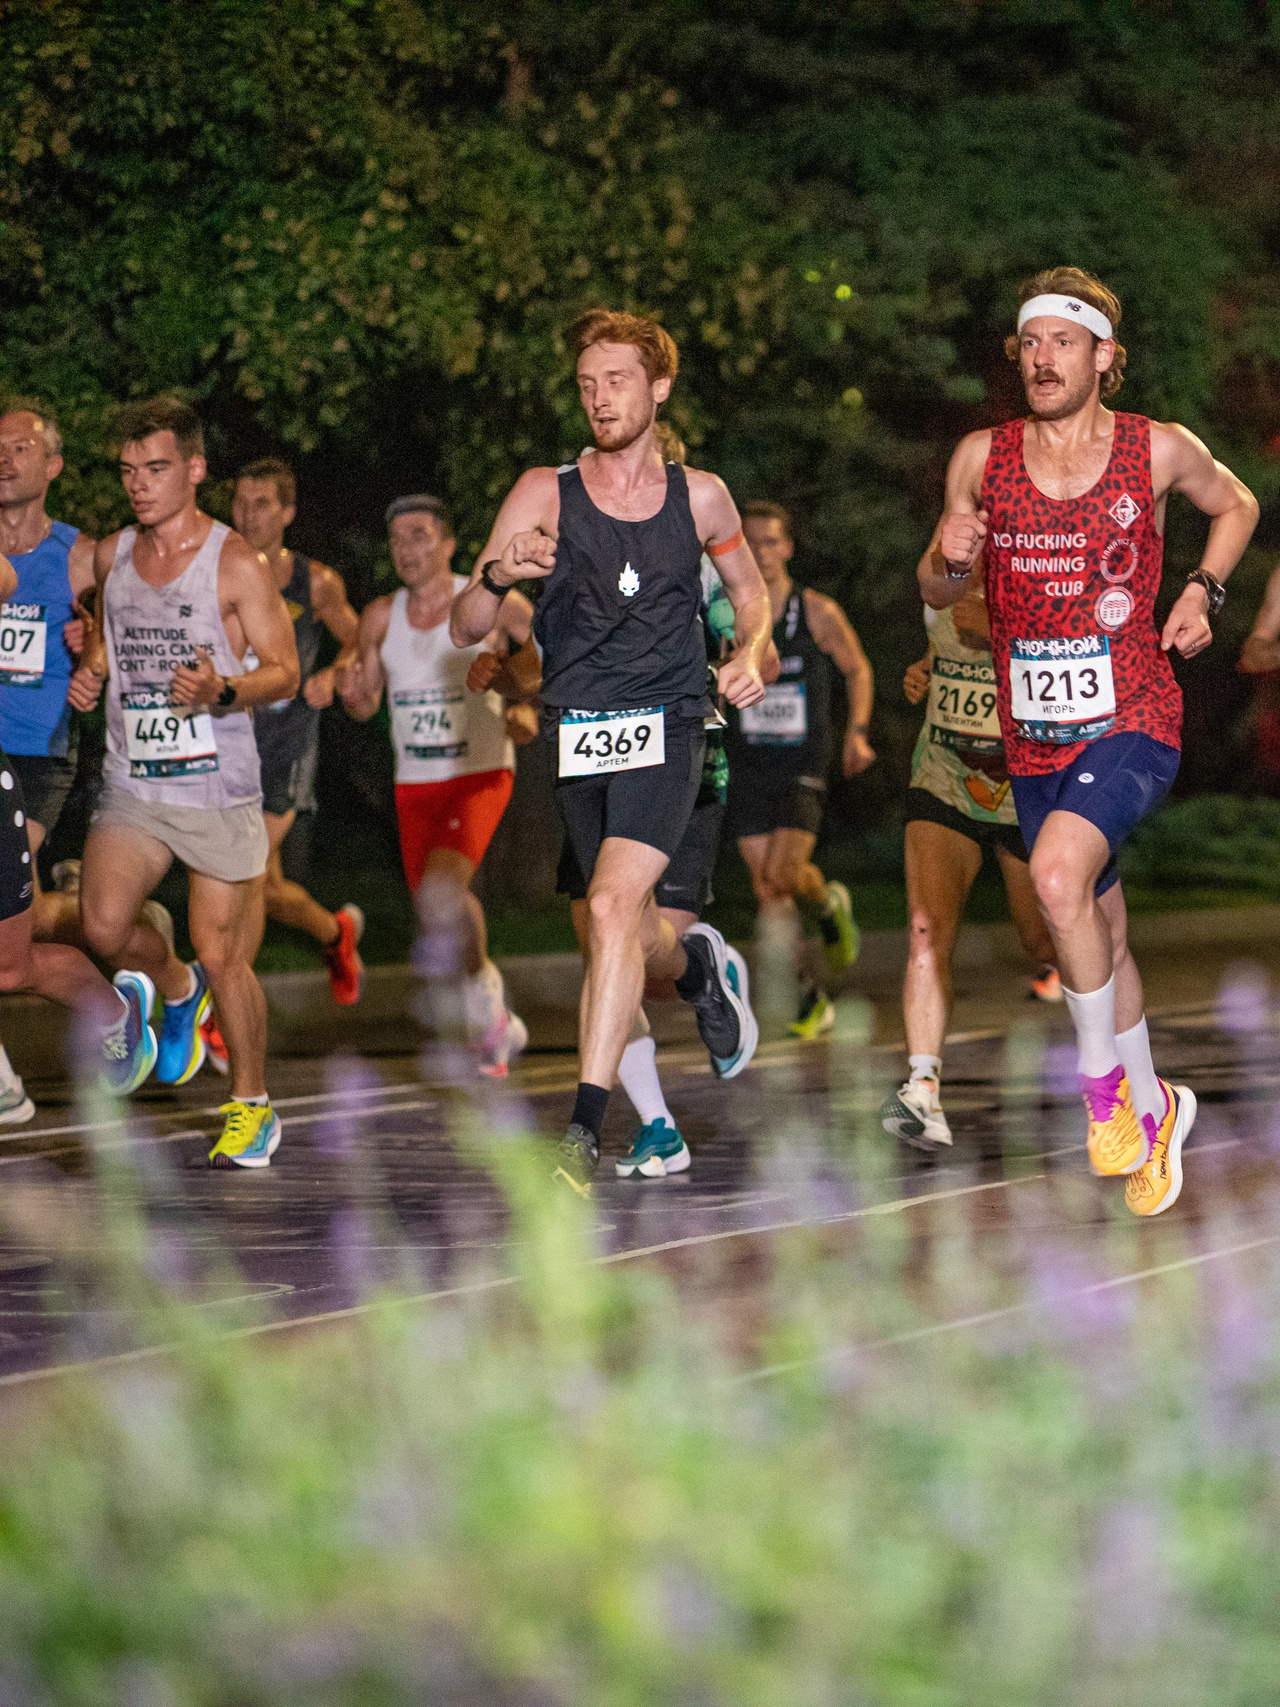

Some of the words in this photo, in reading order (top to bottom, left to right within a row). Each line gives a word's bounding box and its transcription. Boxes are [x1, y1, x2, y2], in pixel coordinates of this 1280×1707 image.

[1015, 532, 1087, 549] FUCKING
[1011, 556, 1086, 573] RUNNING
[1044, 580, 1084, 597] CLUB
[1, 628, 36, 654] 07
[124, 627, 187, 641] ALTITUDE
[119, 658, 146, 672] ONT
[1022, 668, 1099, 701] 1213
[938, 685, 996, 719] 2169
[1042, 704, 1076, 714] ИГОРЬ
[135, 713, 197, 743] 4491
[573, 725, 651, 758] 4369
[596, 757, 629, 768] АРТЕМ
